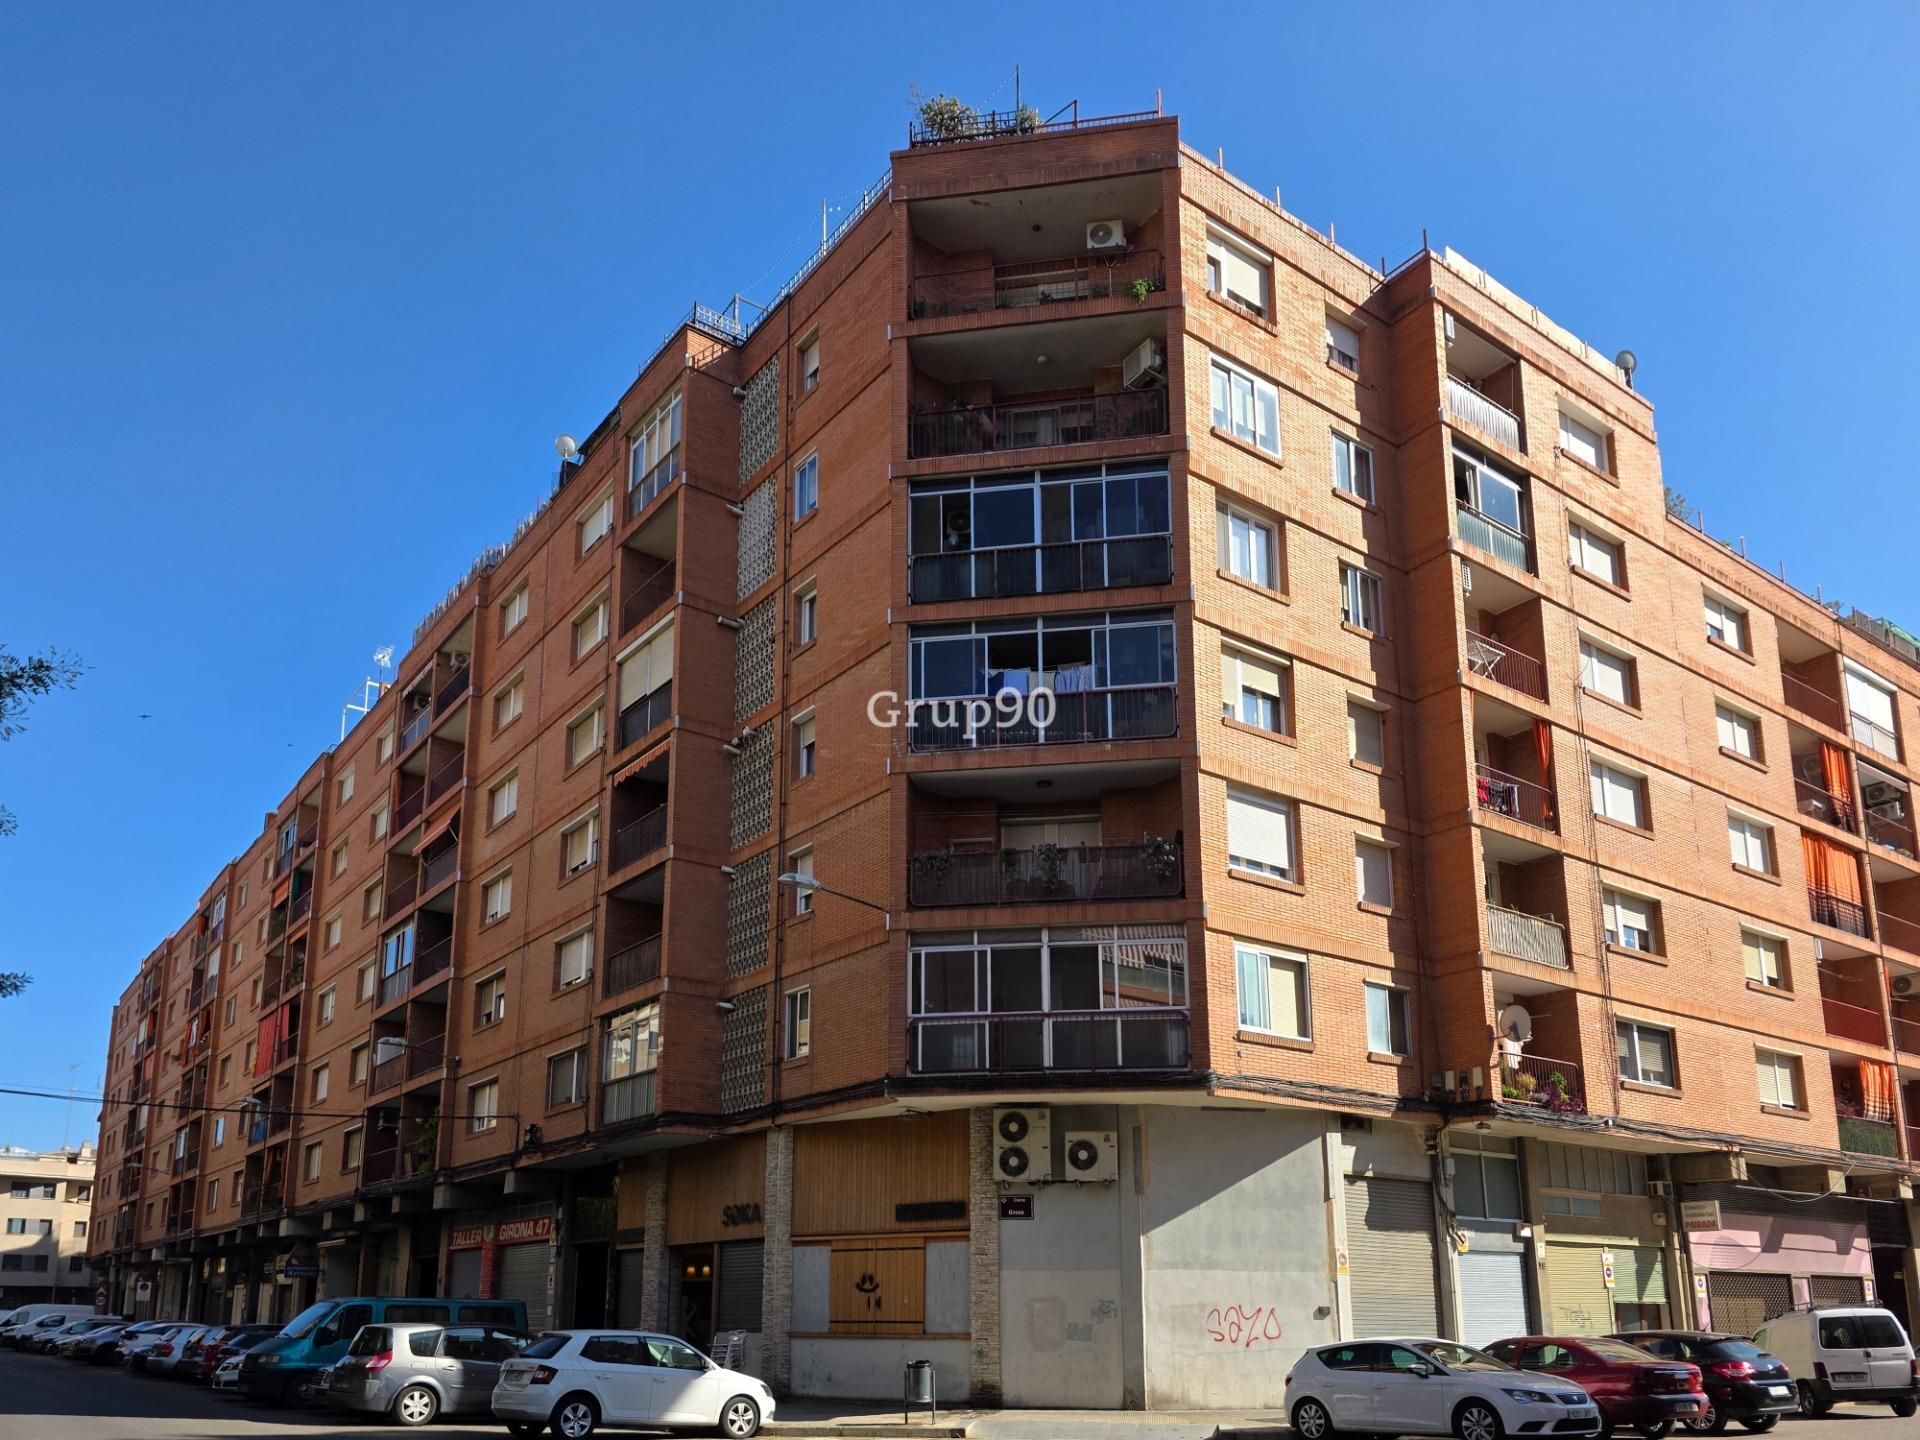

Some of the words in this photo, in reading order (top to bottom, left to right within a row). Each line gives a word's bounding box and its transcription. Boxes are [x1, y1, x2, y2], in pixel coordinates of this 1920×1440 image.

[452, 1229, 482, 1246] TALLER
[499, 1220, 534, 1241] GIRONA
[535, 1219, 550, 1236] 47
